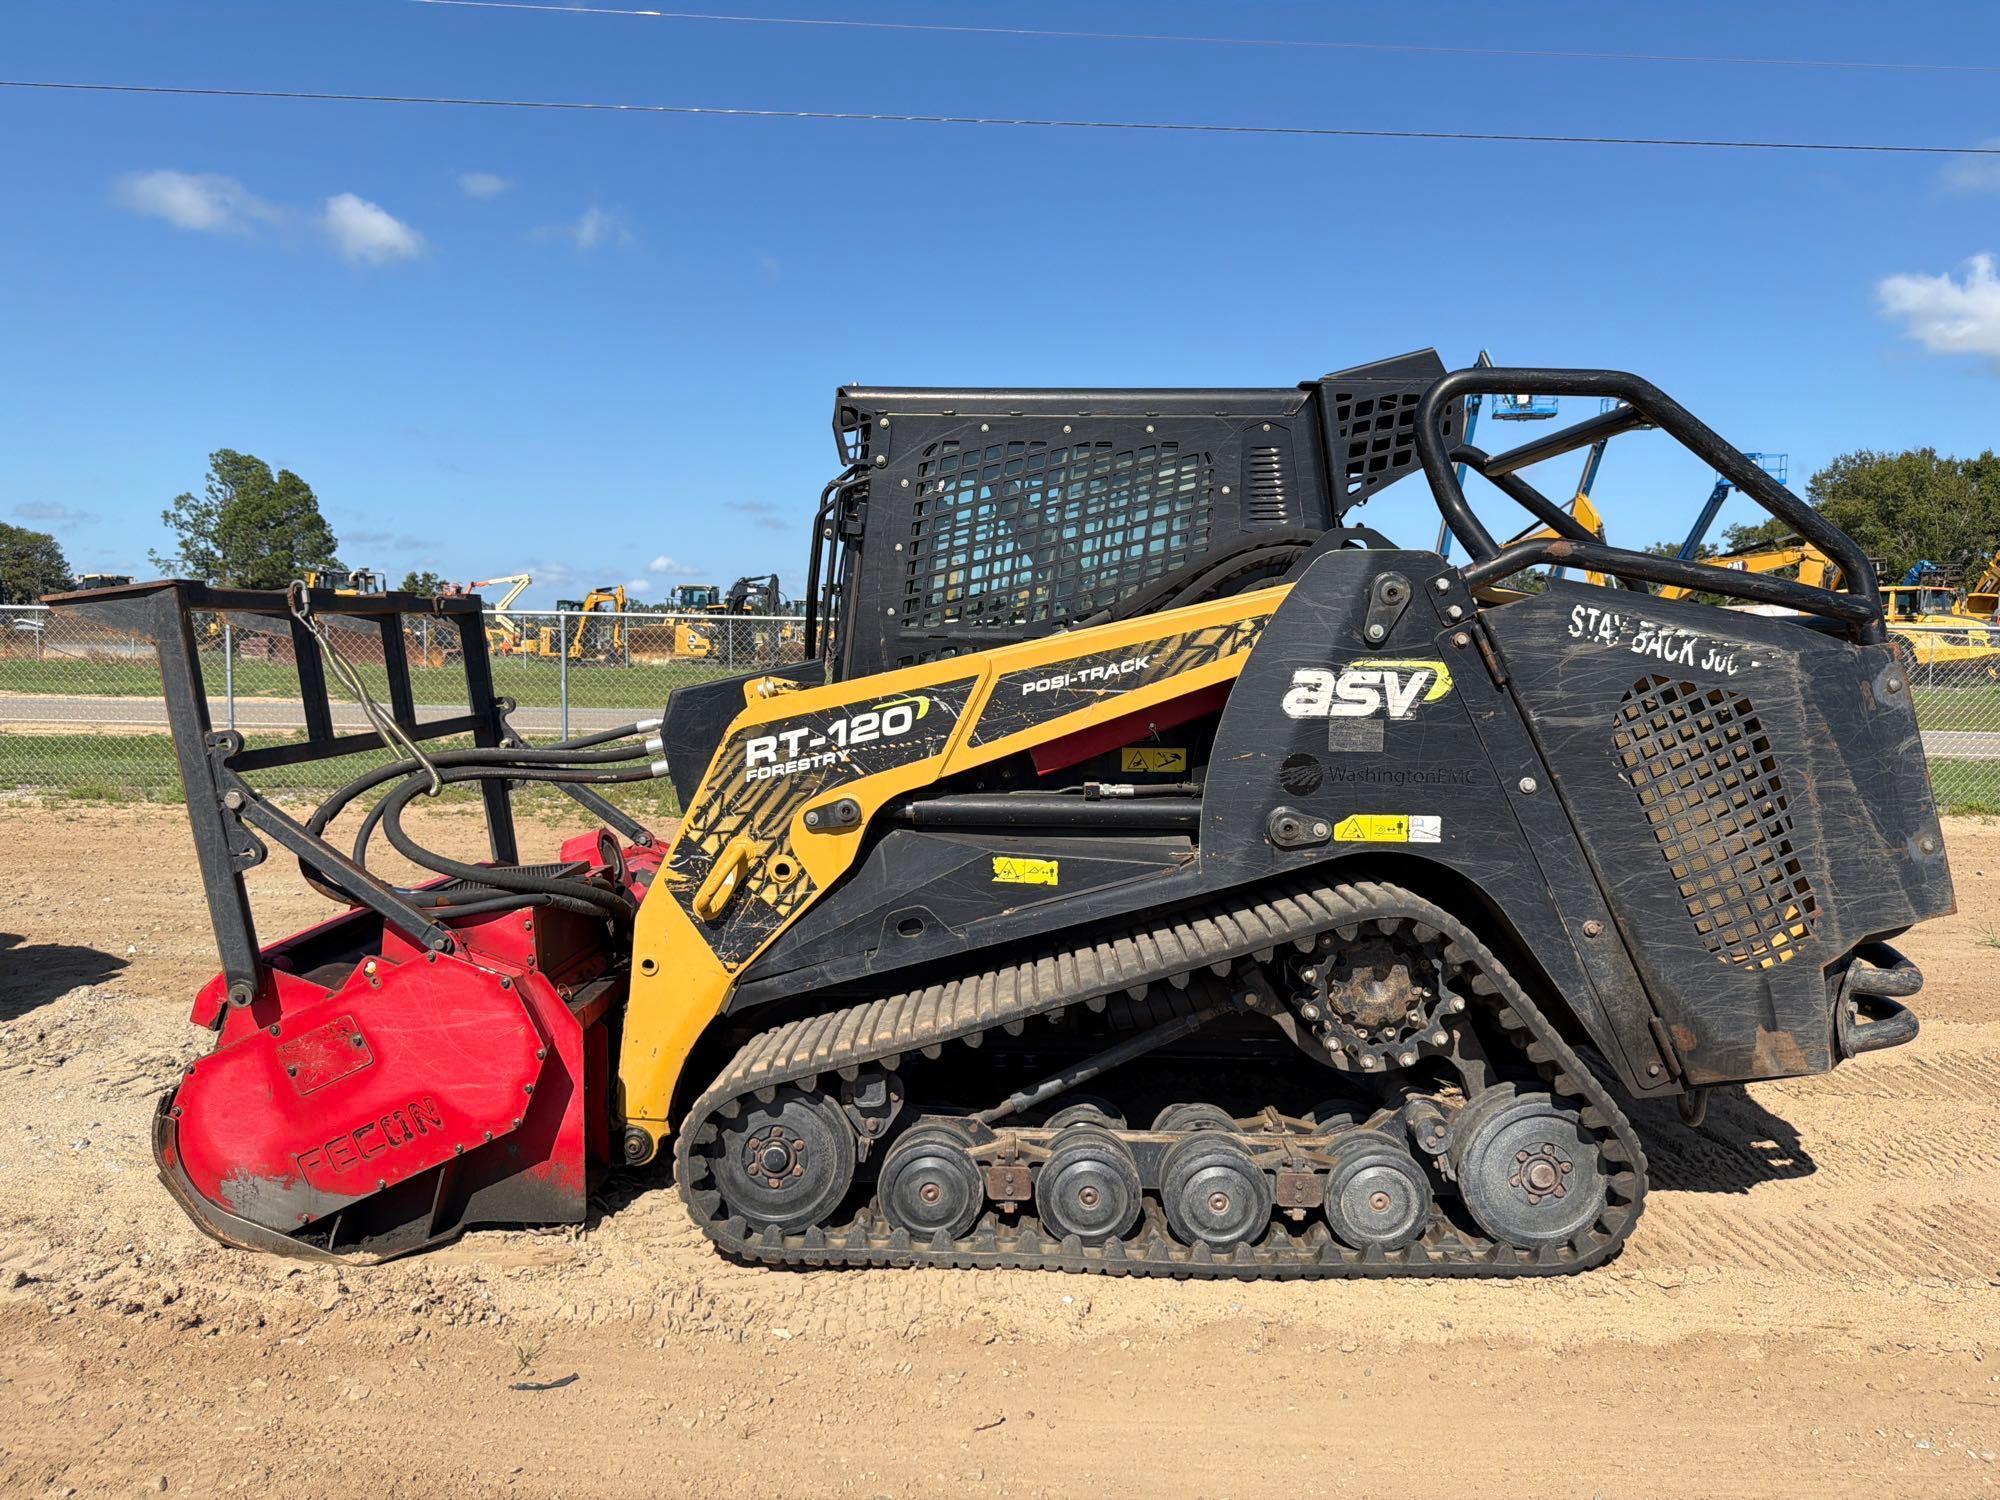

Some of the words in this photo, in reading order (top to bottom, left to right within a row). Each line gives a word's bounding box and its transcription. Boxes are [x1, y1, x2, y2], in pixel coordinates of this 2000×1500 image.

[1630, 620, 1698, 667] BACK
[1022, 656, 1150, 696] POSI-TRACK
[745, 705, 914, 767] RT-120
[745, 749, 851, 783] FORESTRY
[1329, 766, 1477, 786] WashingtonEMC
[296, 1097, 443, 1187] FECON
